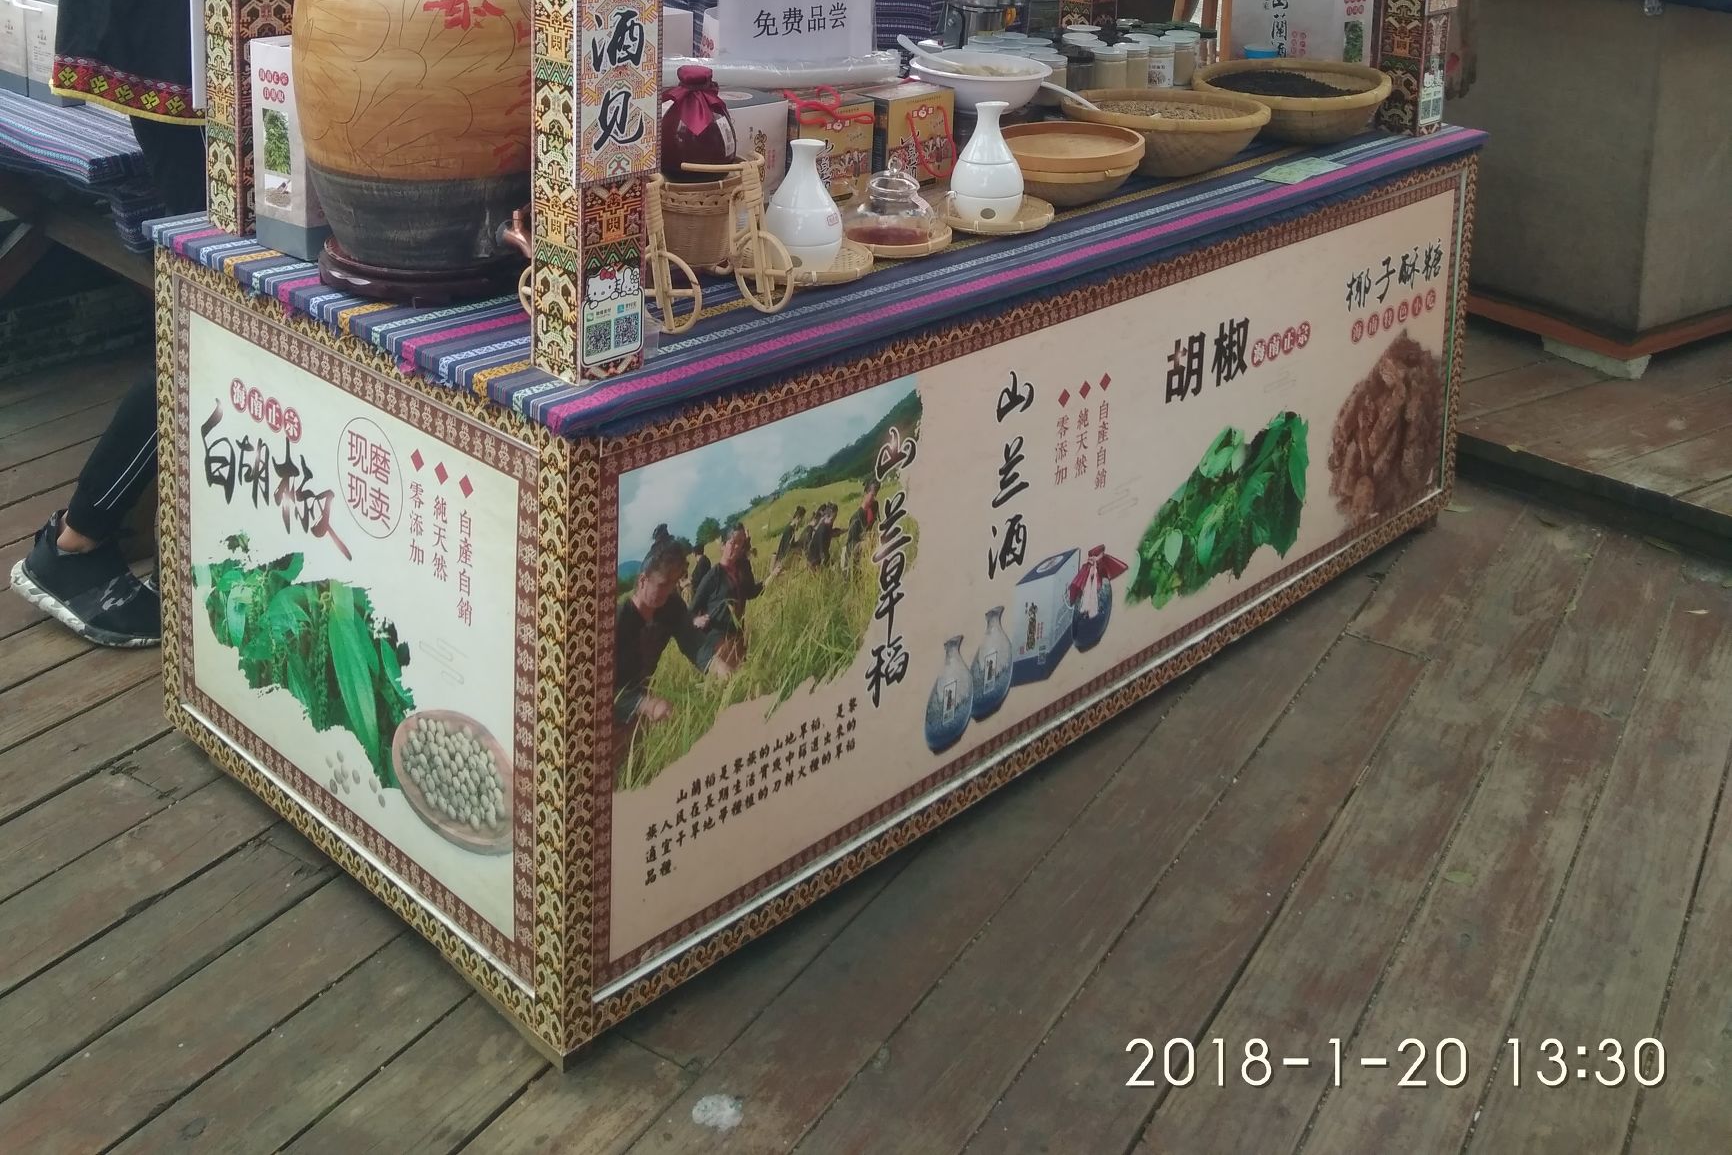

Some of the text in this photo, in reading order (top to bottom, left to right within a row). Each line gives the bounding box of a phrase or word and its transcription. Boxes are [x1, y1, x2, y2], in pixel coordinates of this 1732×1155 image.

[753, 2, 847, 39] 免费品尝
[1165, 317, 1250, 404] 胡椒
[1252, 321, 1311, 367] 海南正宗
[231, 379, 301, 442] 海南正宗
[1055, 414, 1070, 486] 零添加
[200, 397, 352, 561] 白胡椒
[347, 430, 391, 485] 现磨
[988, 371, 1034, 580] 山兰酒
[347, 471, 391, 530] 现卖
[409, 480, 424, 566] 零添加
[432, 494, 449, 583] 純天然
[456, 509, 474, 627] 自產自銷
